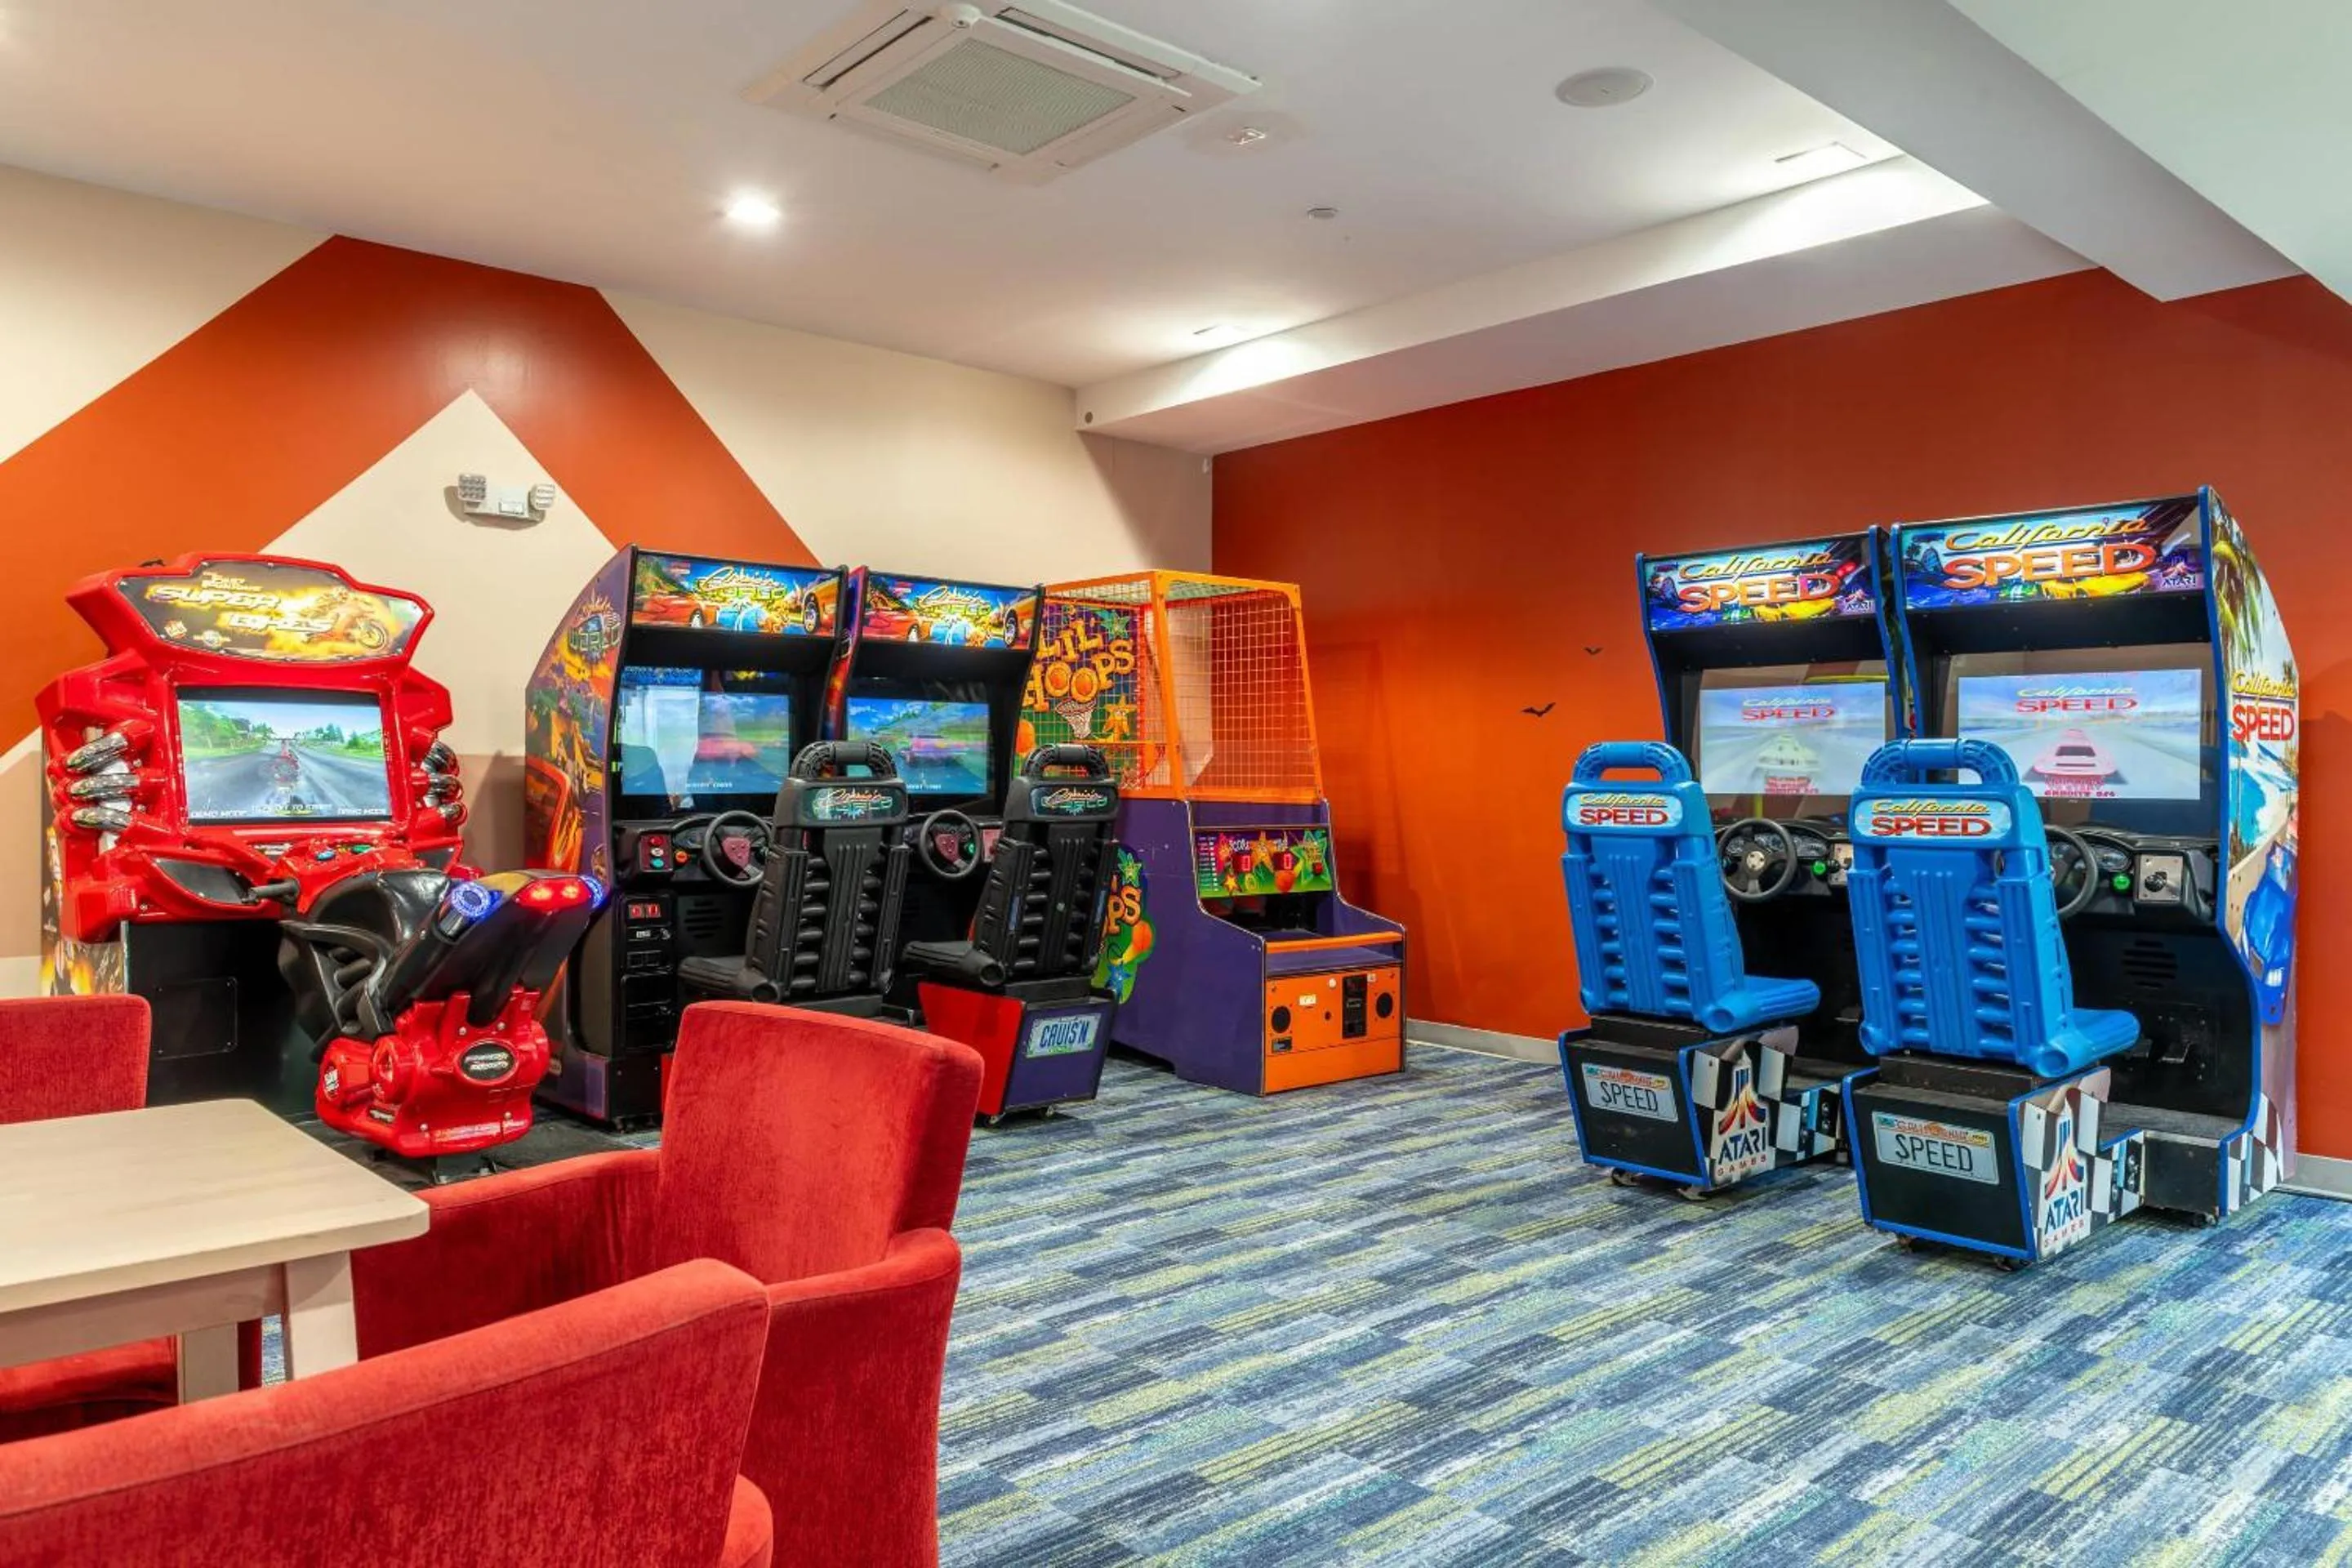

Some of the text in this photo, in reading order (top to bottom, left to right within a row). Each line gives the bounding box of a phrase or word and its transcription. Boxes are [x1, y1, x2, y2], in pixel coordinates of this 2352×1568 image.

[1945, 518, 2149, 554] California
[1679, 552, 1833, 581] California
[1942, 544, 2157, 590] SPEED
[2162, 574, 2197, 587] ATARI
[152, 585, 282, 609] SUPER
[1678, 572, 1841, 612] SPEED
[1846, 600, 1872, 611] ATARI
[1022, 639, 1134, 713] HOOPS
[2232, 671, 2296, 701] California
[1741, 706, 1835, 721] SPEED
[2015, 698, 2139, 713] SPEED
[2232, 703, 2295, 742] SPEED
[1579, 793, 1667, 808] California
[1872, 799, 1990, 817] California
[1579, 808, 1668, 825] SPEED
[1871, 817, 1992, 836] SPEED
[1040, 1020, 1089, 1048] CRUIS'N
[1601, 1080, 1659, 1111] SPEED
[1718, 1127, 1766, 1165] ATARI
[1895, 1134, 1973, 1172] SPEED
[1717, 1154, 1766, 1176] GAMES
[2045, 1187, 2083, 1235] ATARI
